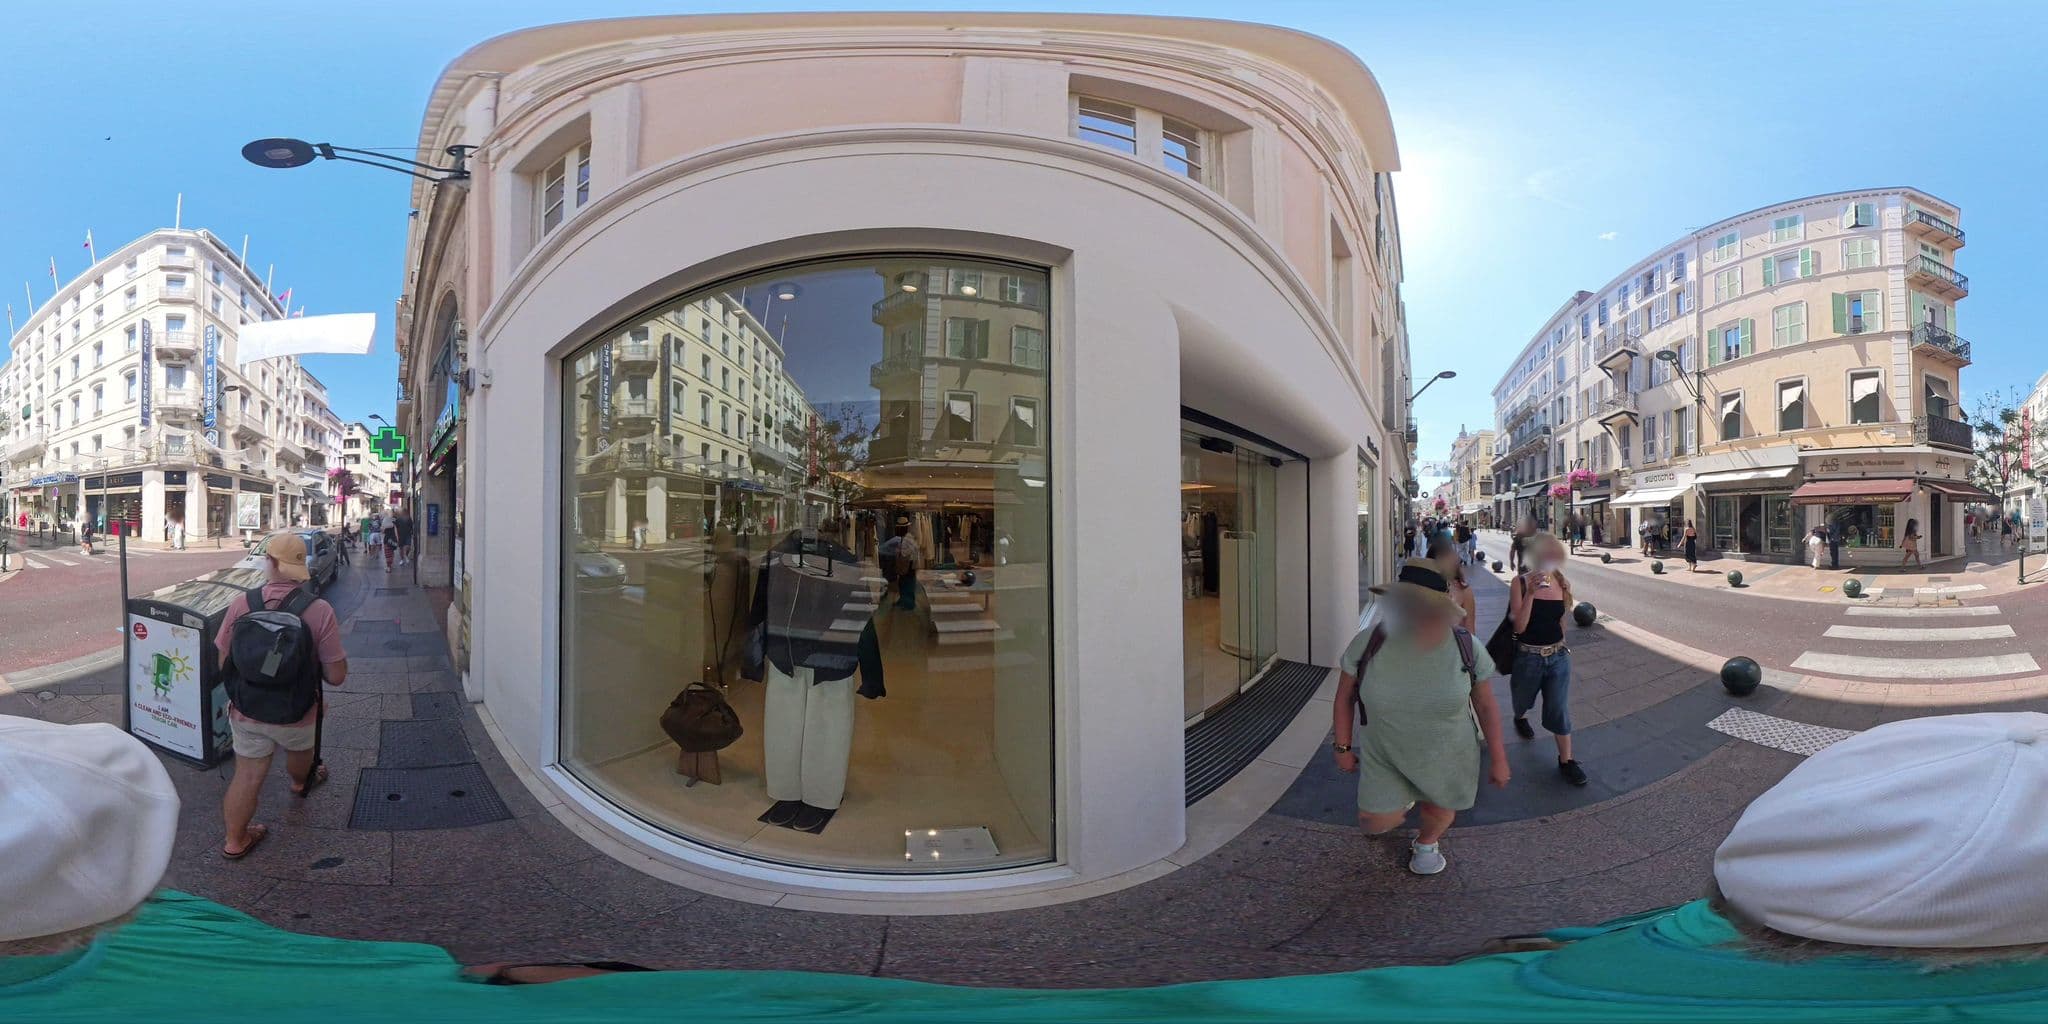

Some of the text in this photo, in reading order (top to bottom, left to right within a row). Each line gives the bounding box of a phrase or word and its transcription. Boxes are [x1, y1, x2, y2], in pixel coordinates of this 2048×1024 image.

[1645, 473, 1668, 484] swatch
[137, 703, 152, 713] CLEAN
[152, 709, 162, 717] AND
[162, 712, 197, 730] ECO-FRIENDLY
